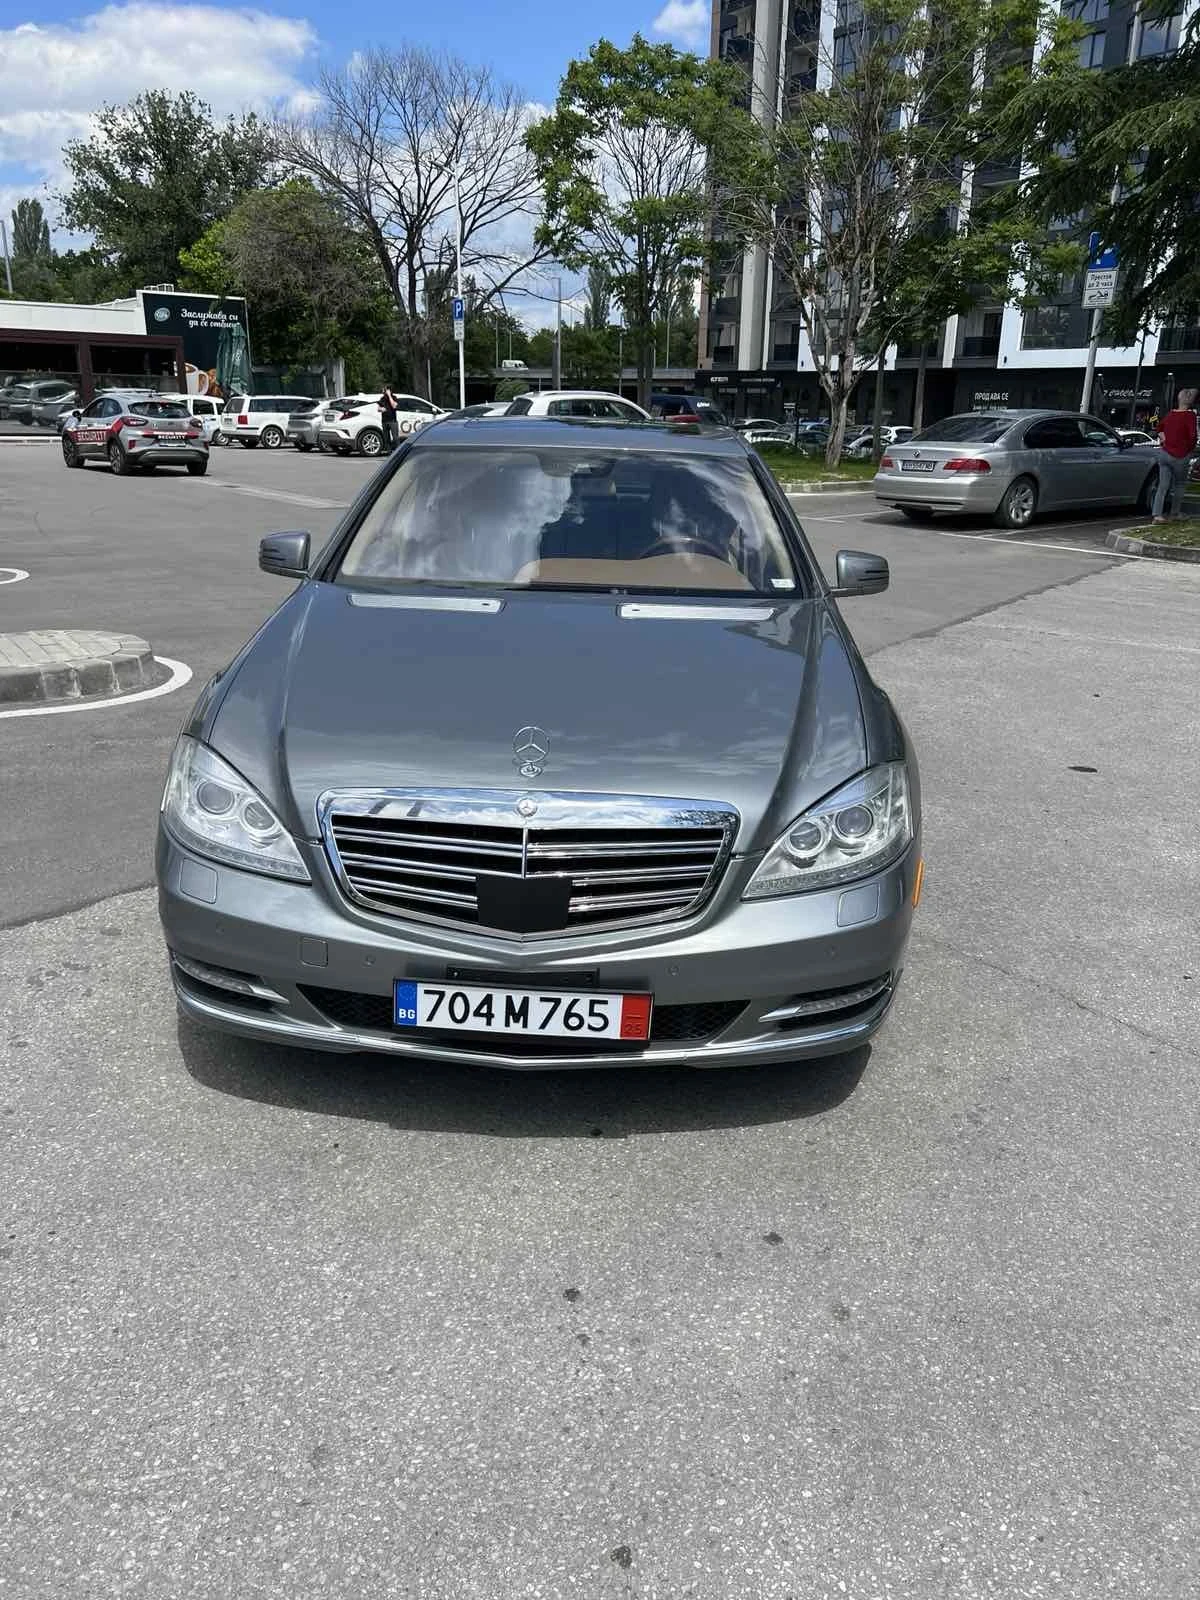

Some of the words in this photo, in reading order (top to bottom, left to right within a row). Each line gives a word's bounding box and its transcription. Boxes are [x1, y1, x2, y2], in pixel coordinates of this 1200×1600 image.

[455, 301, 462, 318] P
[189, 320, 199, 328] да
[77, 431, 107, 441] SECURITY
[398, 1008, 416, 1019] BG
